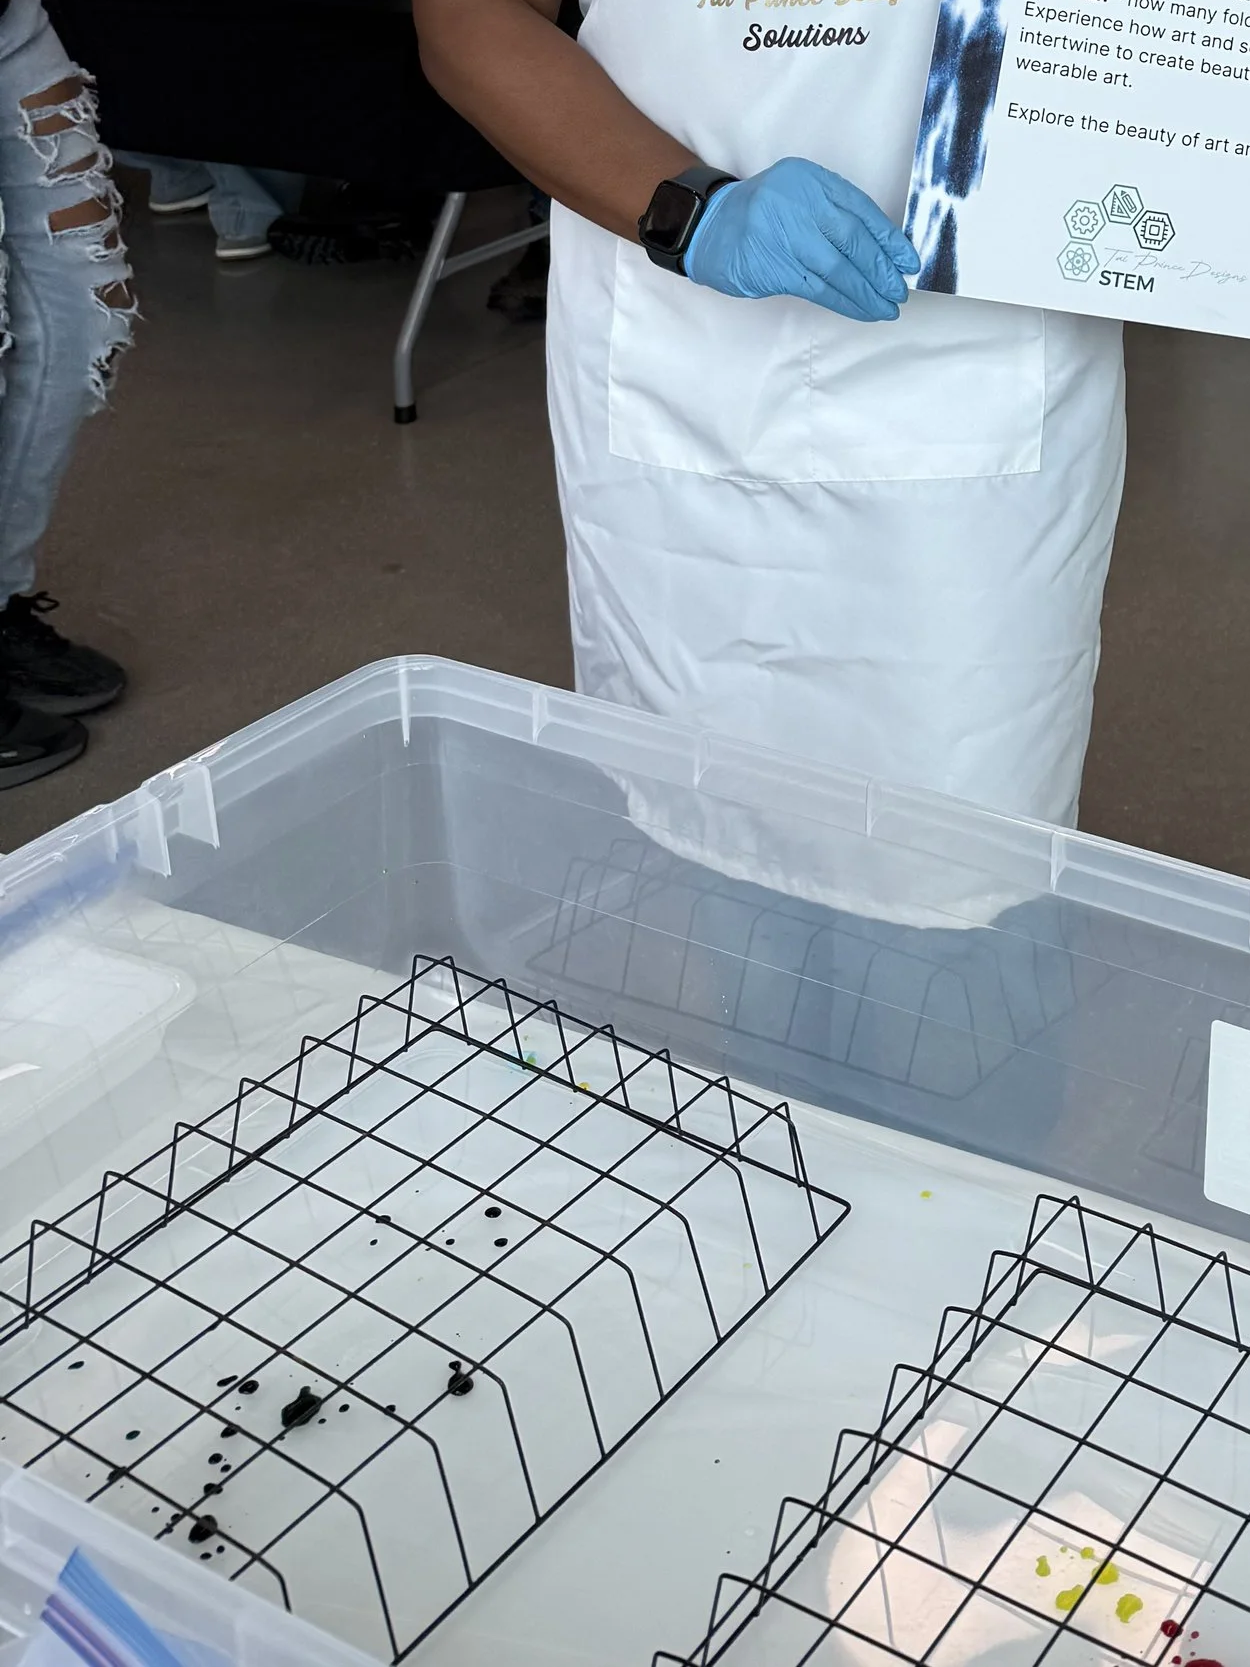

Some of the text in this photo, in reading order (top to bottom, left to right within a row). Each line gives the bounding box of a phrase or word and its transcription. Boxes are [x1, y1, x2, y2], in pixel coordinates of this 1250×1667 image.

[1024, 0, 1124, 32] Experience
[1128, 18, 1167, 39] how
[1171, 29, 1197, 45] art
[1201, 35, 1234, 51] and
[1170, 2, 1218, 25] many
[742, 22, 870, 52] Solutions
[1019, 26, 1111, 57] intertwine
[1115, 44, 1133, 61] to
[1138, 51, 1195, 72] create
[1016, 56, 1132, 88] wearable art.
[1007, 101, 1075, 128] Explore
[1080, 114, 1110, 133] the
[1115, 119, 1177, 148] beauty
[1181, 132, 1201, 148] of
[1204, 137, 1230, 154] art
[1098, 269, 1155, 293] STEM
